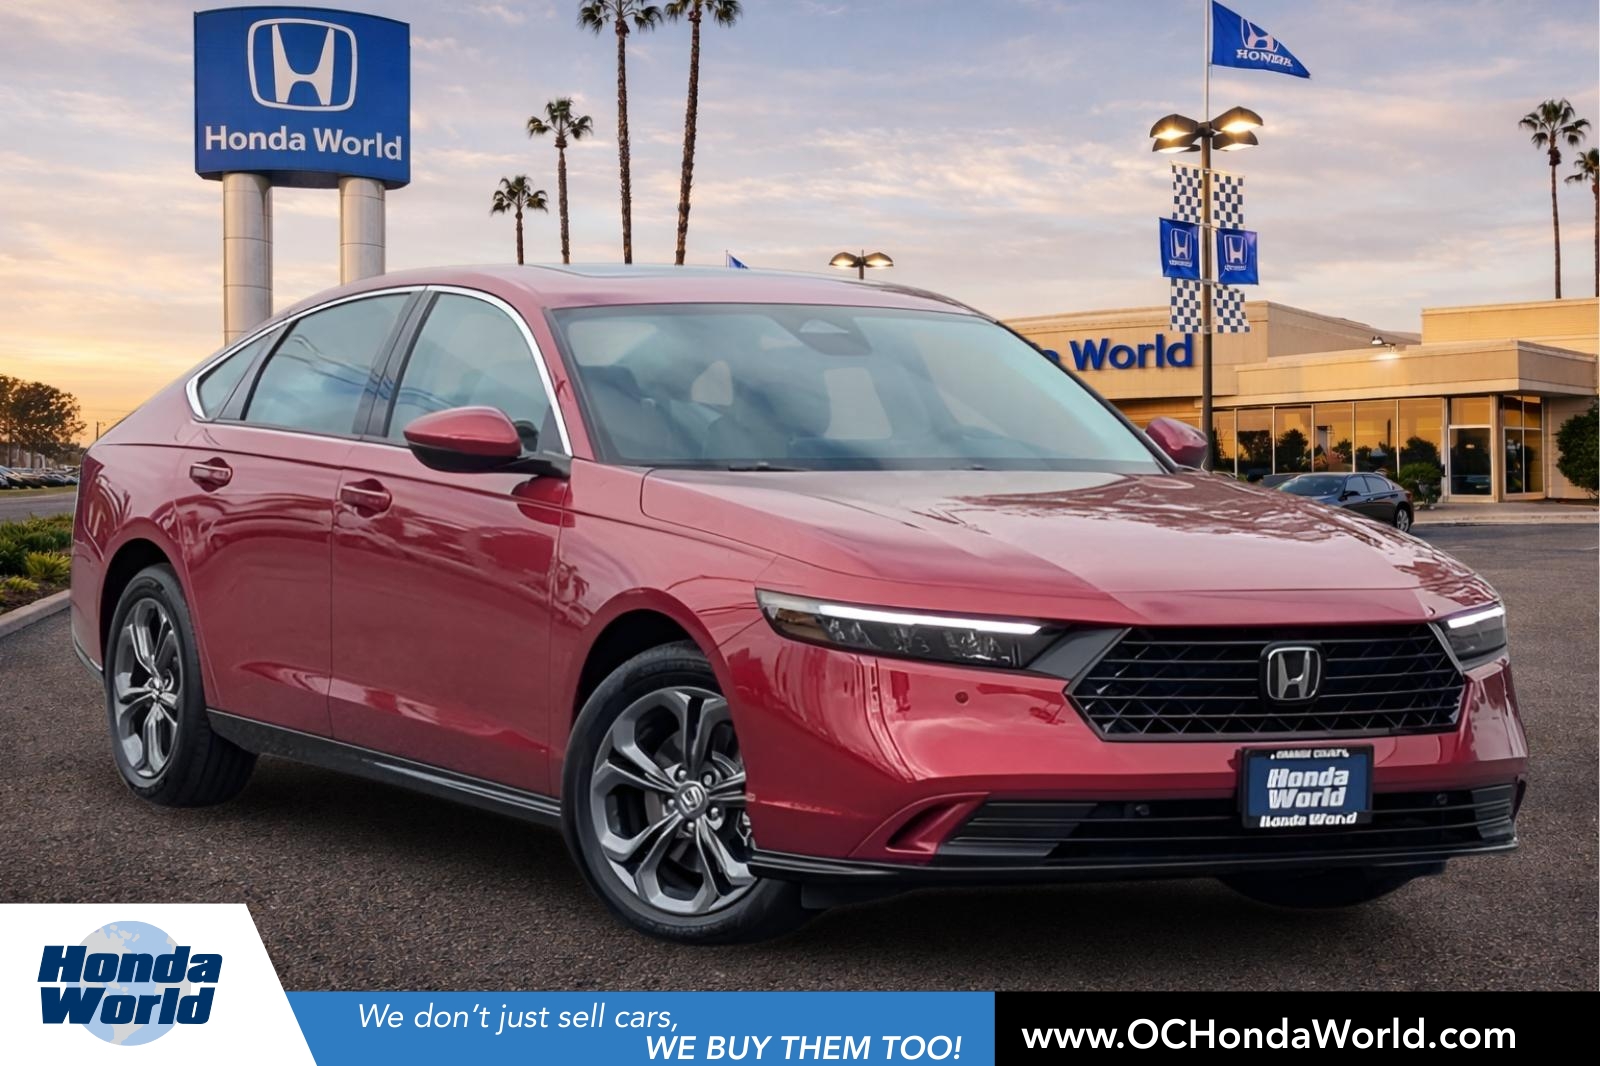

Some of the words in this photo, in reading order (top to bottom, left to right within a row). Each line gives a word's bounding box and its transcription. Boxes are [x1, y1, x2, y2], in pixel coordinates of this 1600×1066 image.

[205, 125, 306, 151] Honda
[313, 127, 402, 161] World
[1069, 333, 1194, 371] World
[1267, 766, 1349, 789] Honda
[1269, 787, 1347, 809] World
